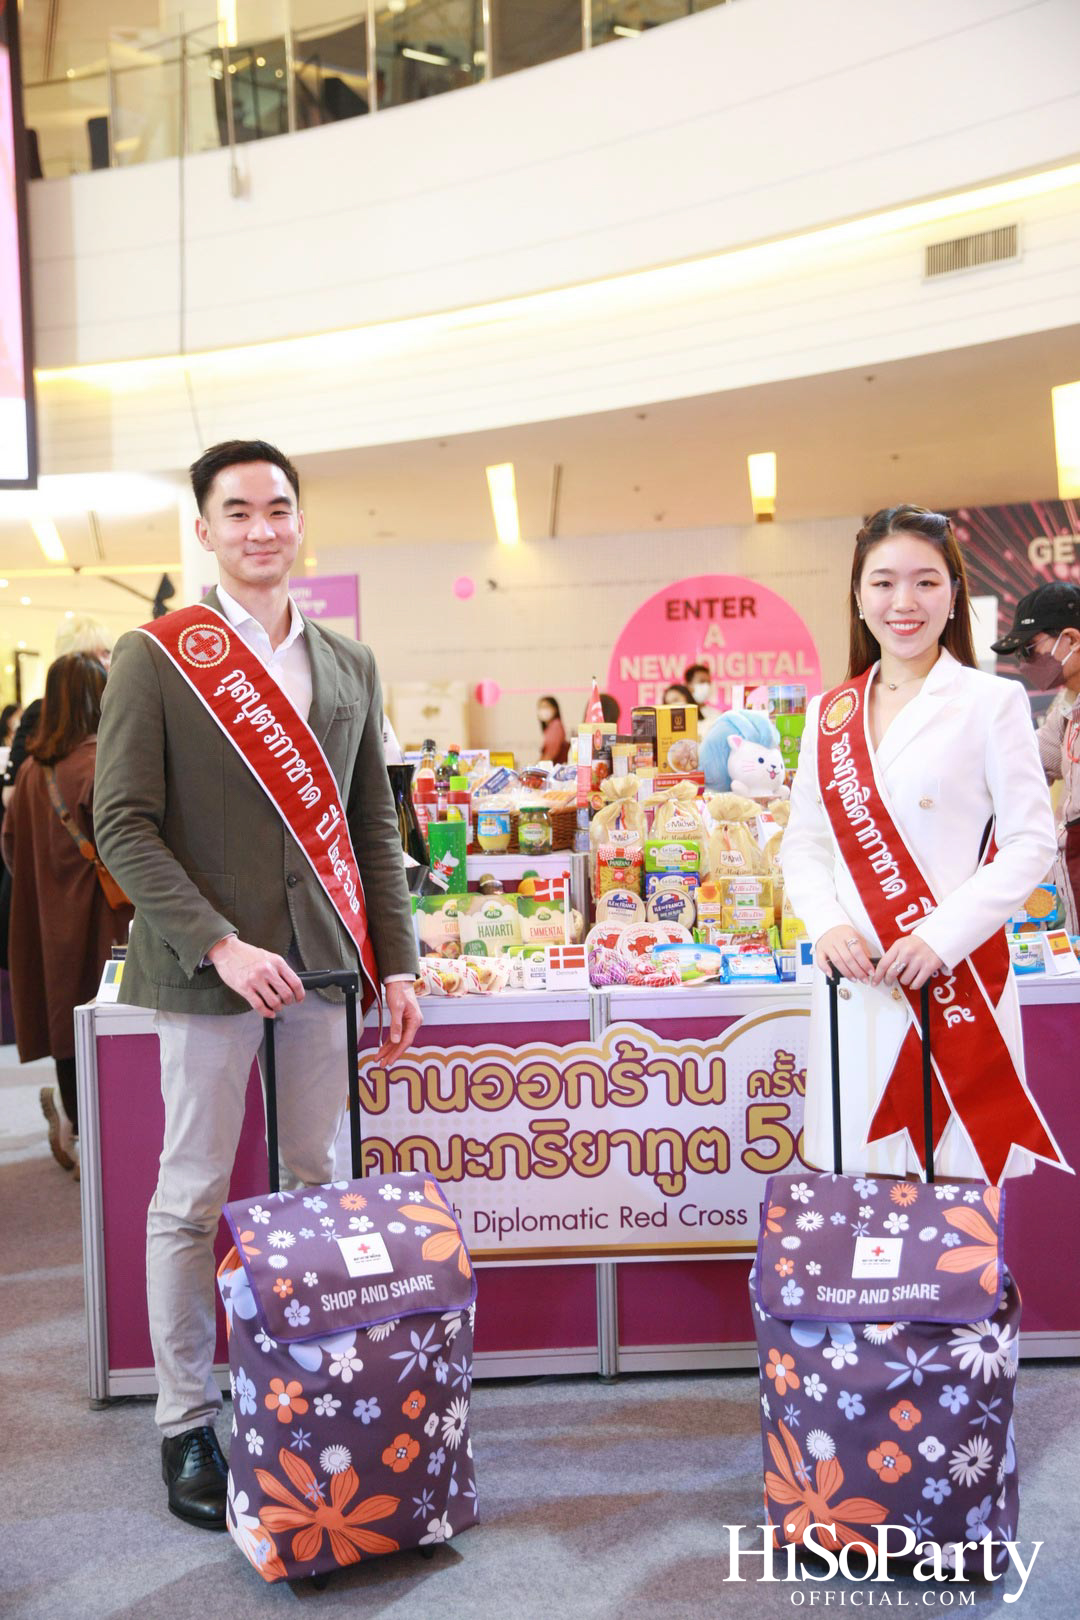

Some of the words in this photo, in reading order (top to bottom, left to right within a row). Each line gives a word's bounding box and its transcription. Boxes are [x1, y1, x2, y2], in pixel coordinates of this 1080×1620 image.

[665, 597, 757, 620] ENTER
[704, 624, 725, 648] A
[619, 654, 687, 680] NEW
[698, 651, 813, 678] DIGITAL
[214, 668, 322, 808] กุลบุตรกาชาด
[315, 804, 341, 840] ปี
[825, 732, 907, 900] รองกุลธิดากาชาด
[486, 910, 501, 918] Arla
[620, 902, 636, 910] FRANCE
[666, 901, 684, 910] FRANCE
[478, 923, 514, 938] HAVARTI
[530, 926, 564, 937] EMMENTAL
[1015, 951, 1028, 960] Sugar
[1028, 950, 1038, 959] Free
[358, 1040, 726, 1115] งานออกร้าน
[473, 1207, 609, 1239] Diplomatic
[620, 1203, 668, 1229] Red
[678, 1202, 748, 1227] Cross
[320, 1289, 357, 1312] SHOP
[361, 1284, 389, 1305] AND
[389, 1274, 436, 1298] SHARE
[816, 1285, 856, 1304] SHOP
[858, 1288, 889, 1305] AND
[892, 1283, 941, 1301] SHARE
